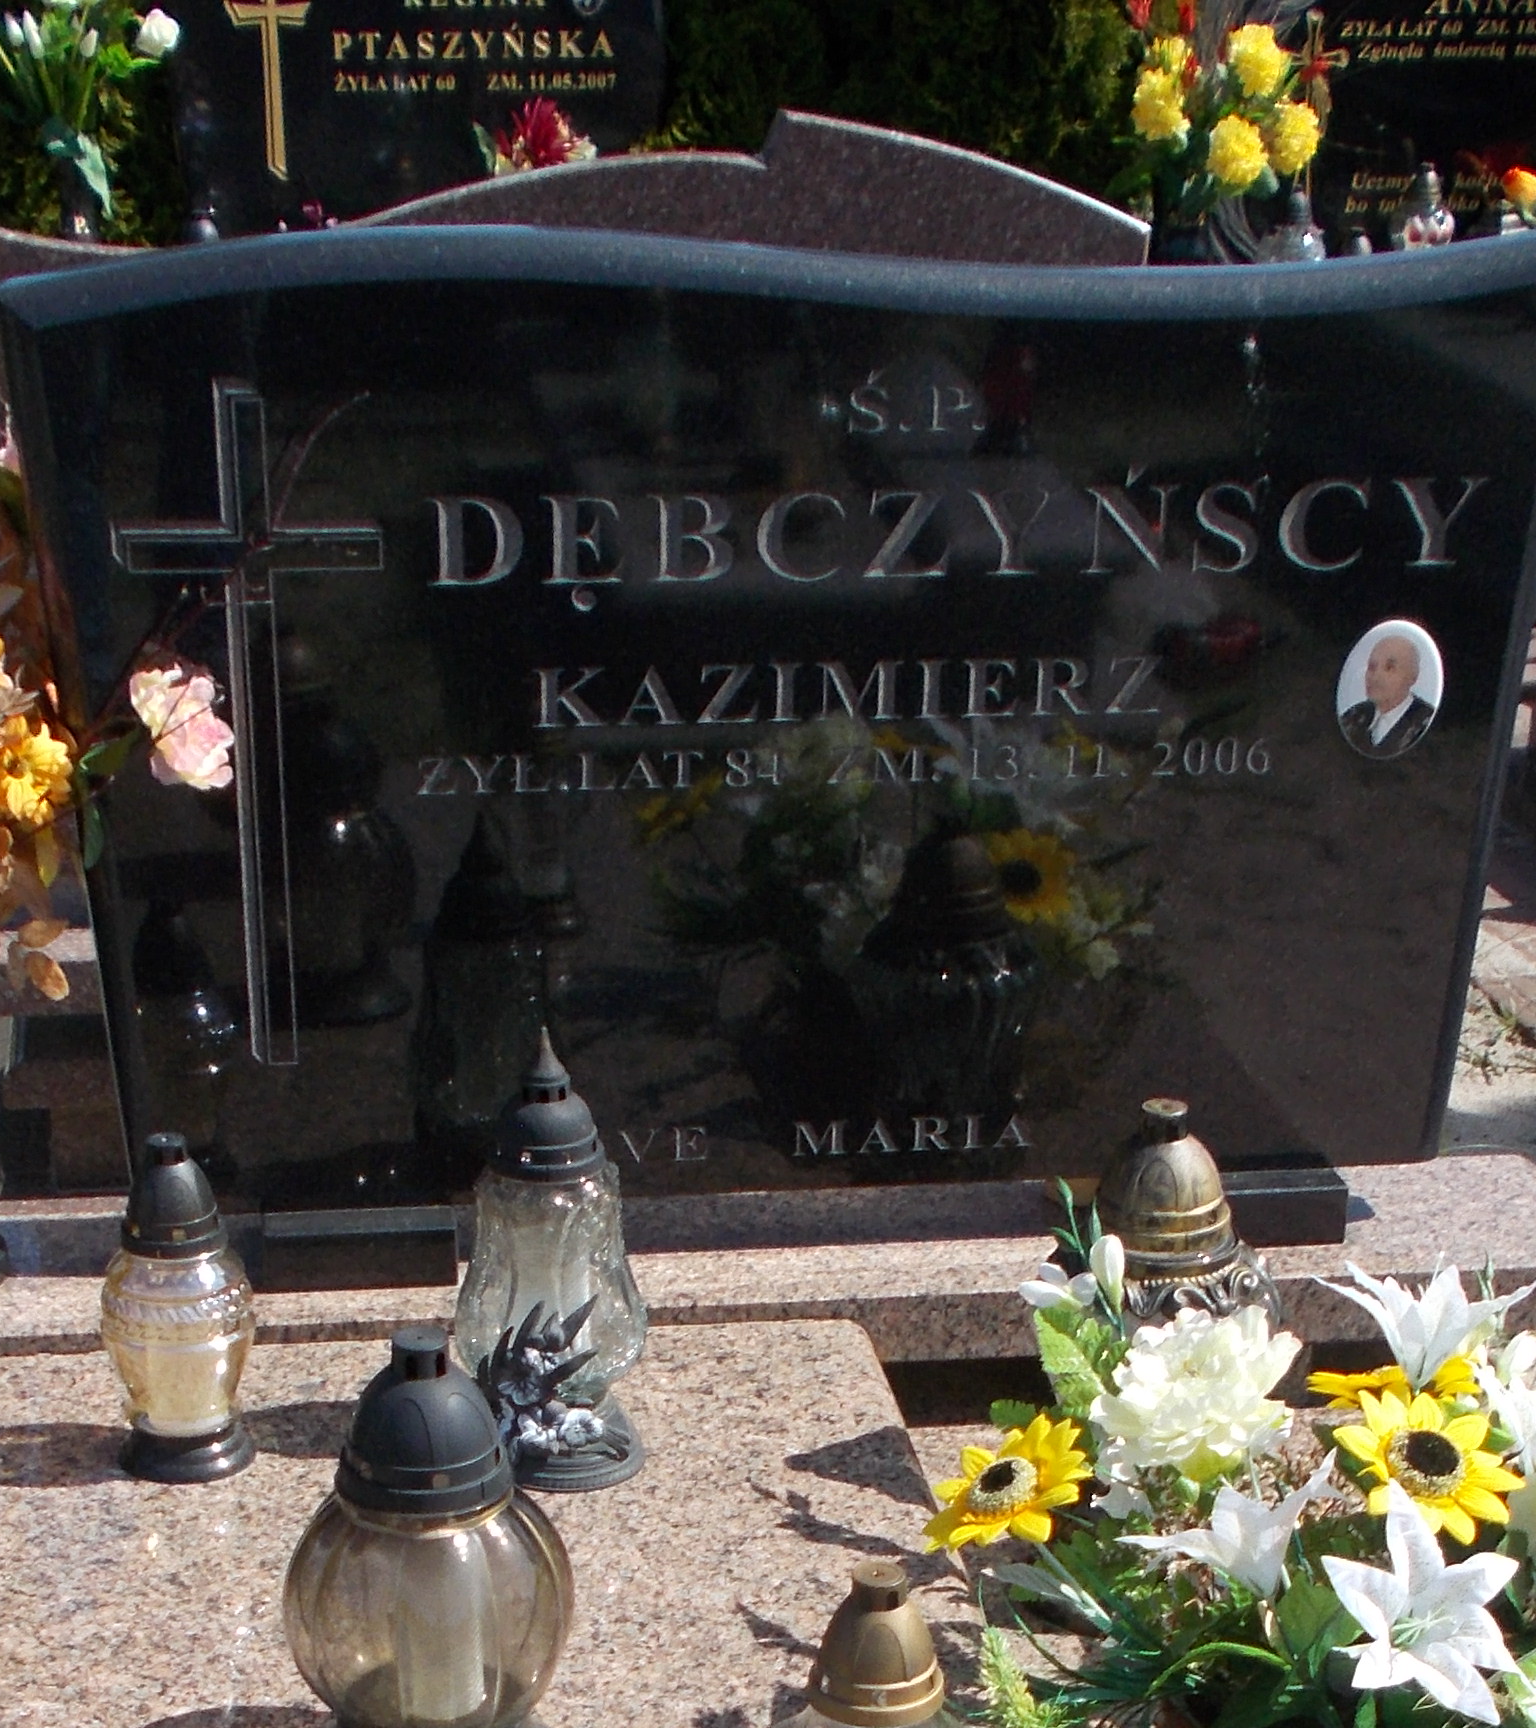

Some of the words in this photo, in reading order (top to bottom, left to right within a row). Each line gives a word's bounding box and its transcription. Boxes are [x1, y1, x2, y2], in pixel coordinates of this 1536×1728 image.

[332, 22, 615, 60] PTASZYŃSKA
[1398, 19, 1438, 38] LAT
[1440, 19, 1464, 37] 60
[392, 73, 432, 91] LAT
[435, 73, 457, 91] 60
[486, 72, 523, 91] ZM.
[427, 465, 1489, 612] DĘBCZYŃSCY
[533, 656, 1161, 728] KAZIMIERZ
[576, 750, 704, 792] LAT
[725, 748, 781, 788] 84
[826, 744, 944, 785] ZM.
[969, 745, 1039, 782] 13.
[1065, 743, 1130, 779] 11.
[1152, 737, 1272, 777] 2006
[619, 1126, 708, 1164] VE
[792, 1112, 1032, 1158] MARIA
